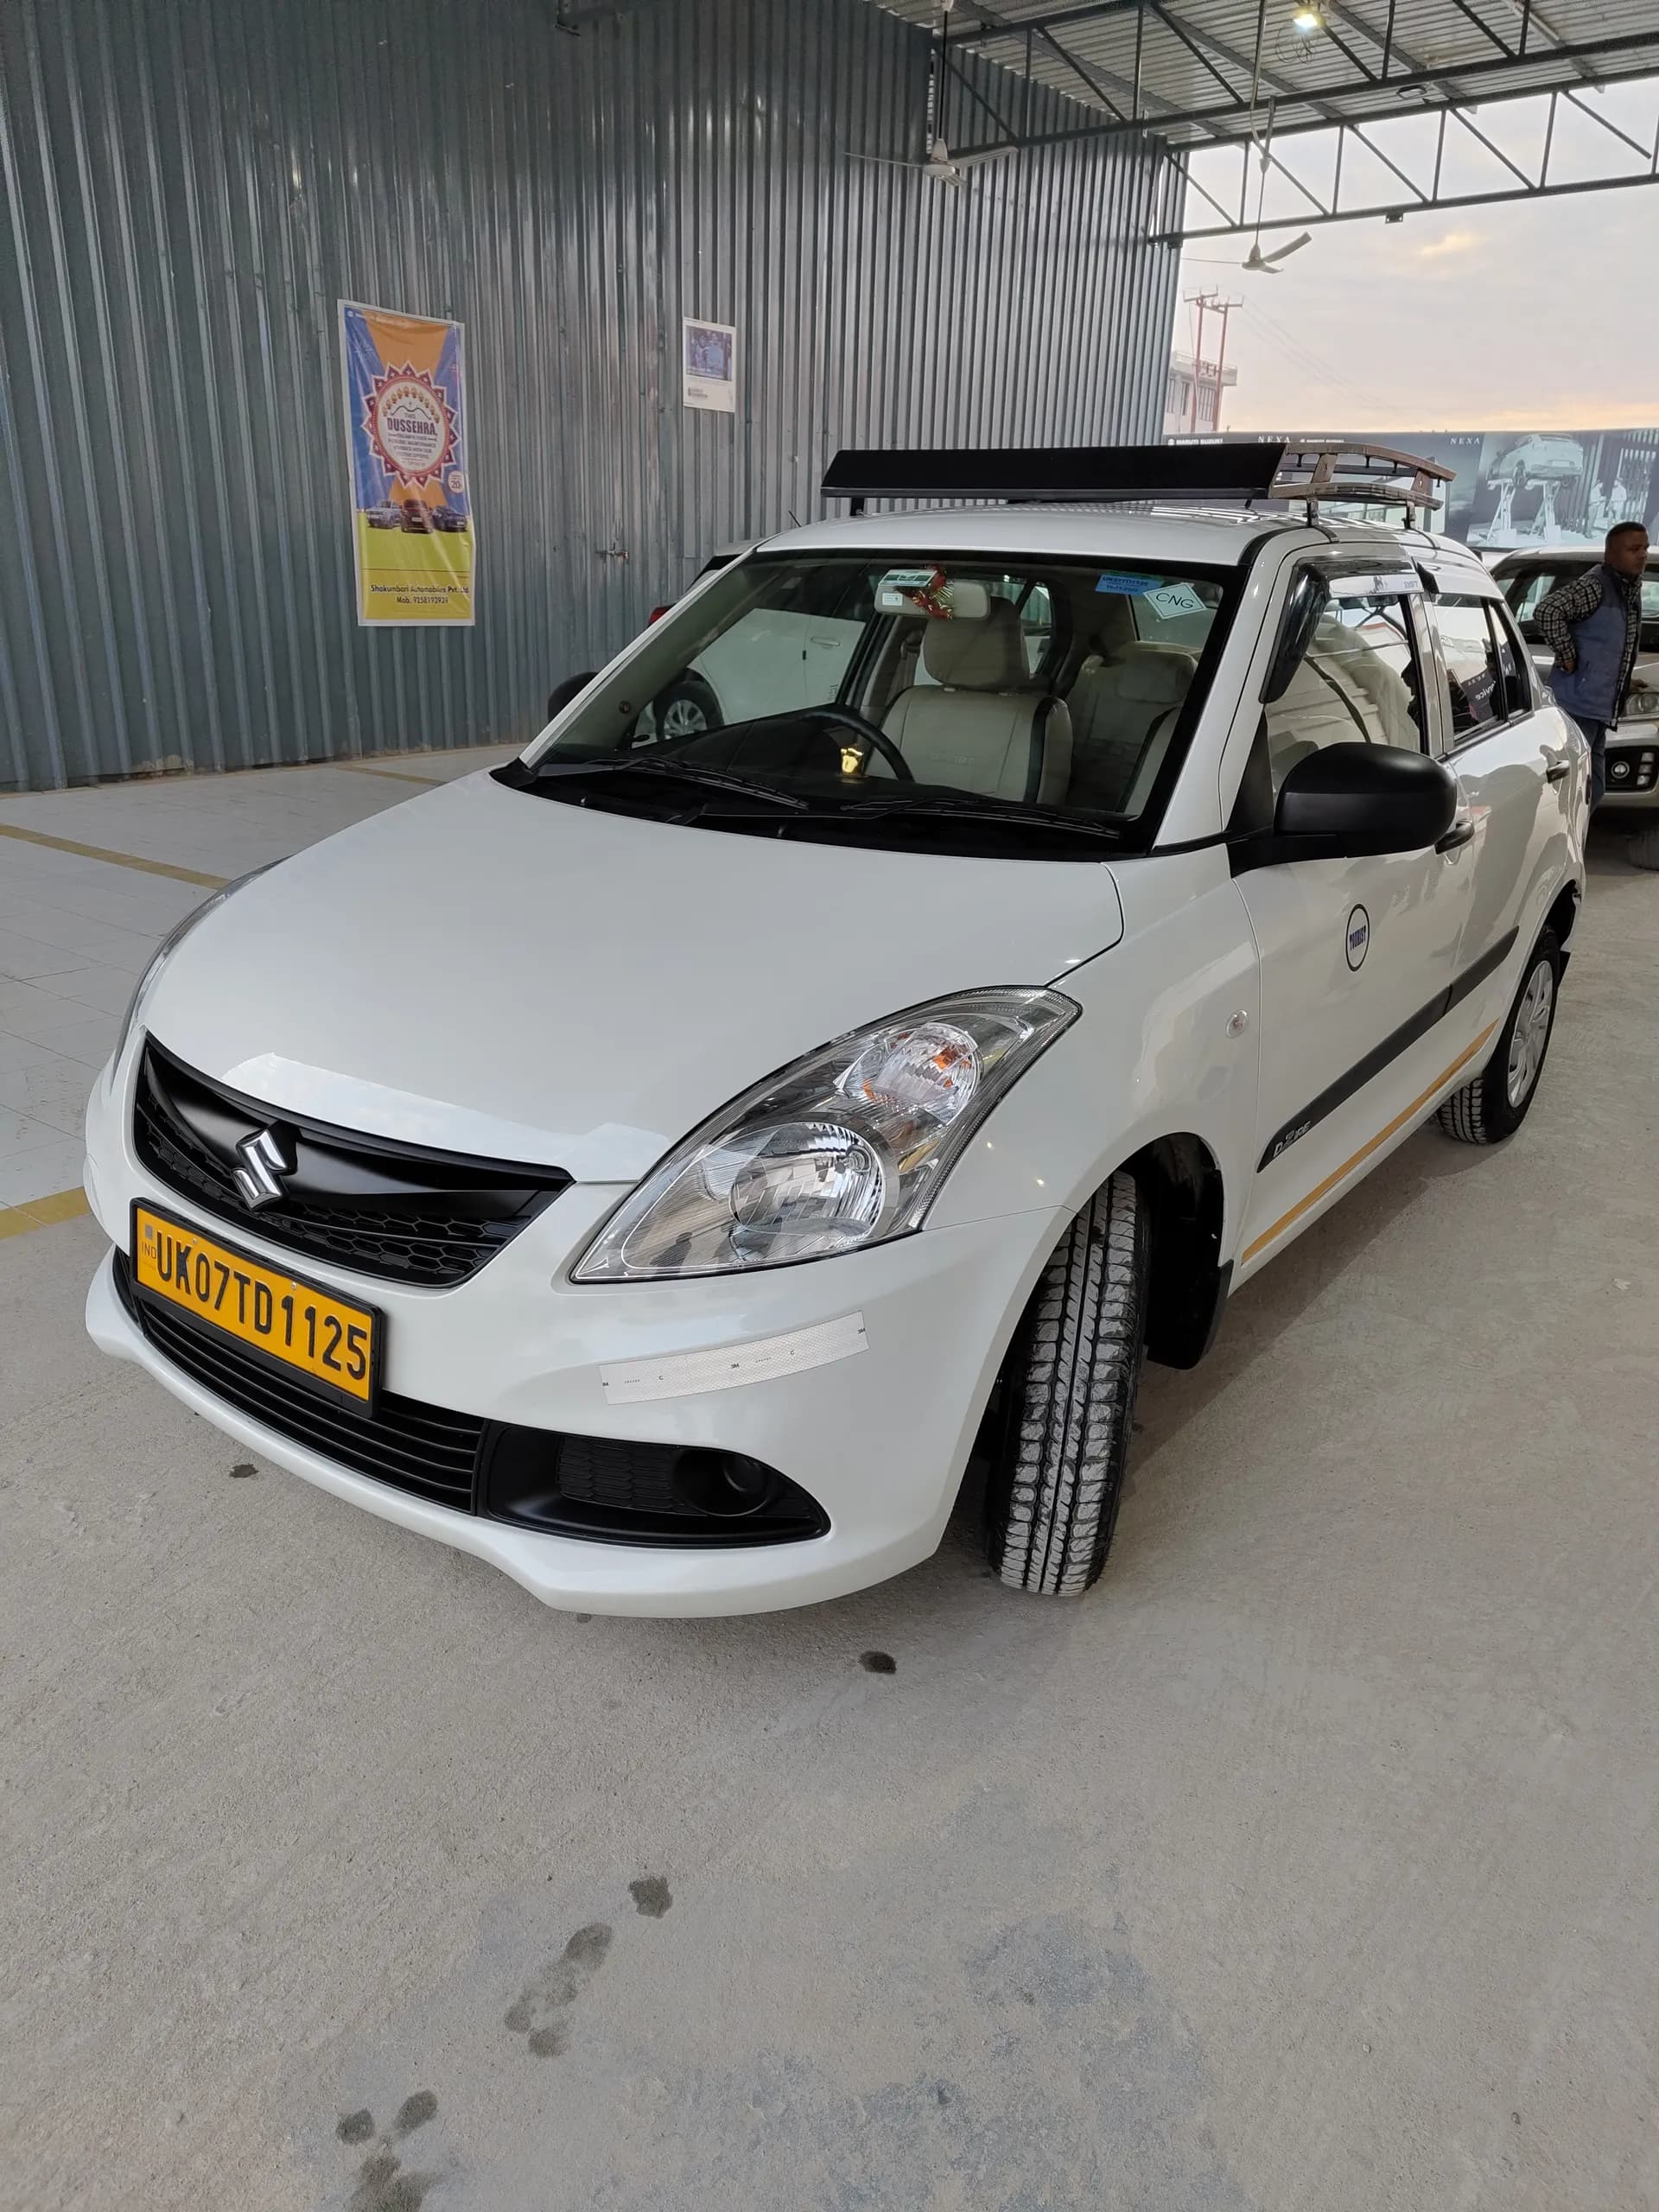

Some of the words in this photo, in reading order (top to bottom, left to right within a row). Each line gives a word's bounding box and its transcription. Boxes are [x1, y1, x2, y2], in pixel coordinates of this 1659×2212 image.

[1155, 592, 1194, 608] CNG
[142, 1240, 156, 1260] IND
[156, 1230, 368, 1381] UK07TD1125
